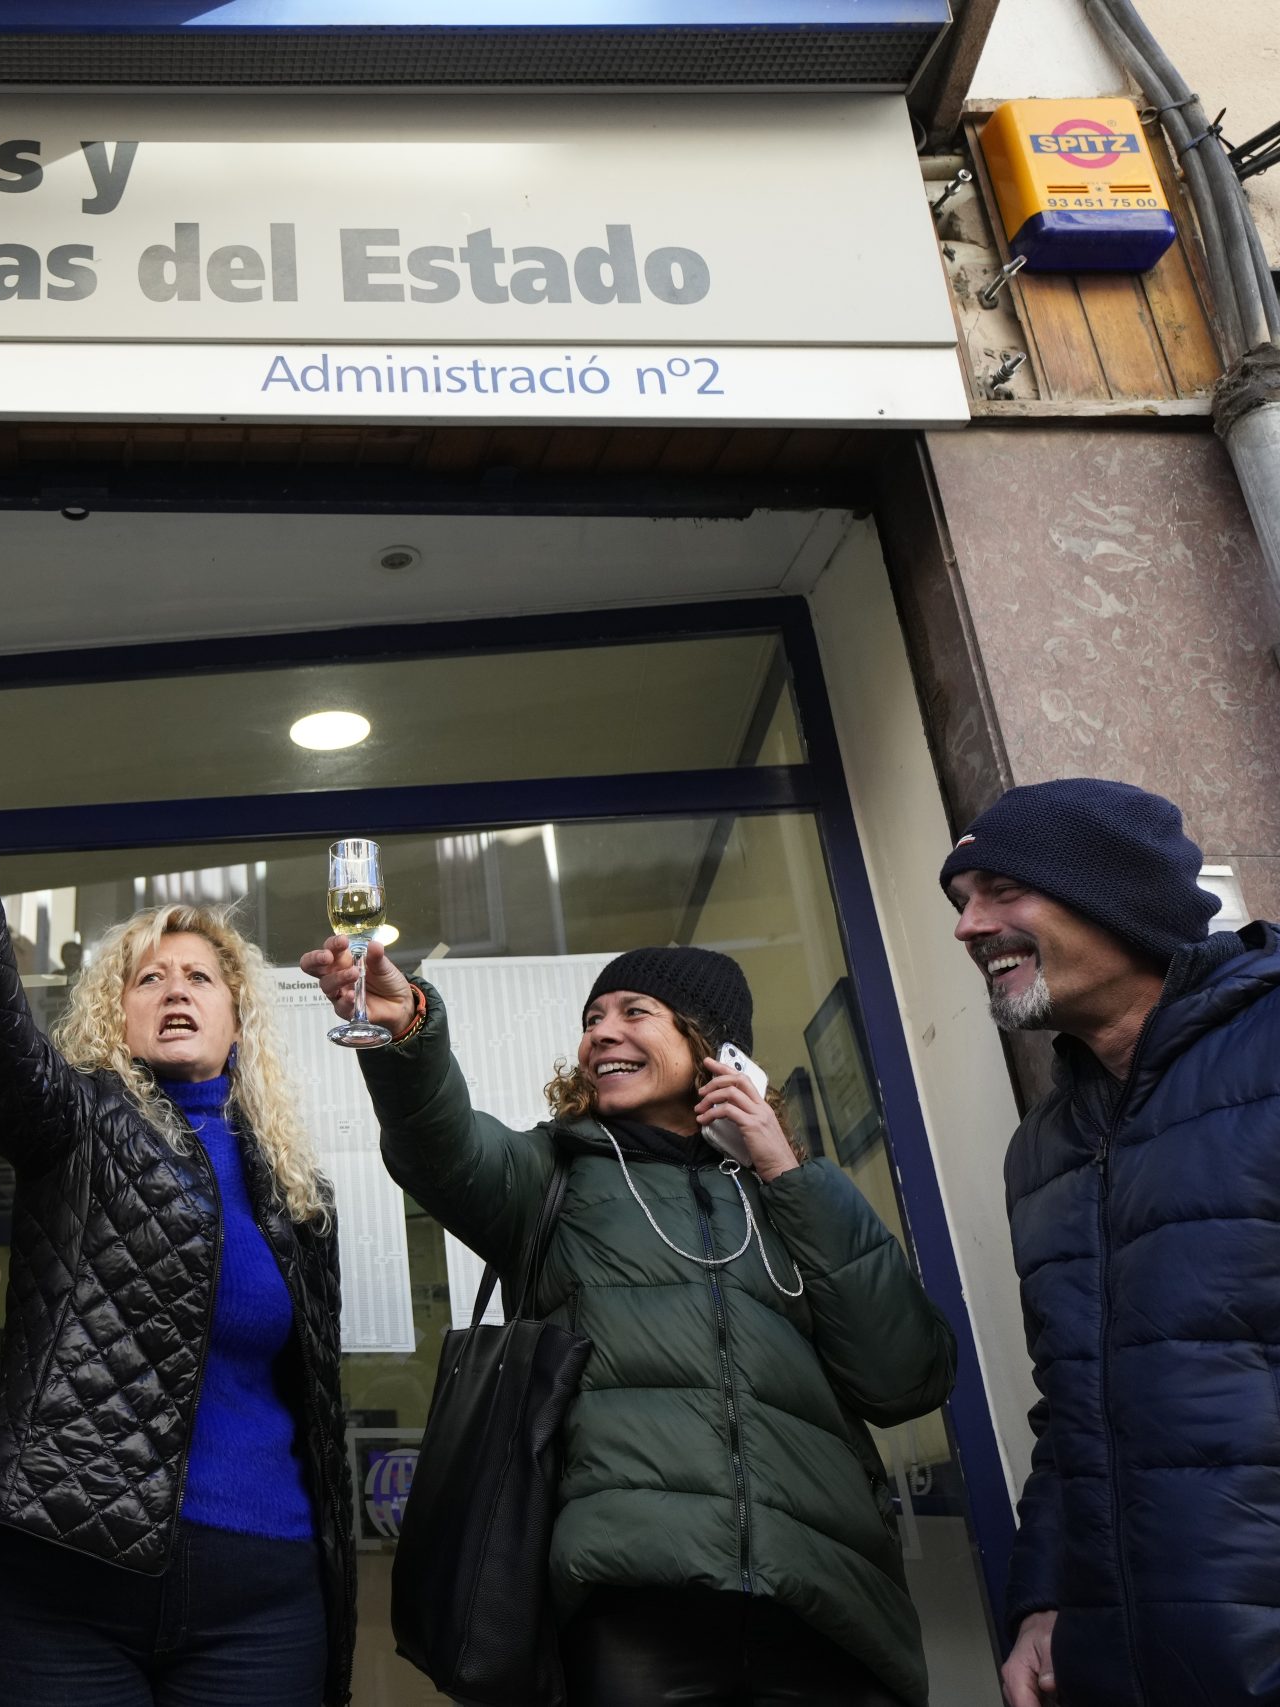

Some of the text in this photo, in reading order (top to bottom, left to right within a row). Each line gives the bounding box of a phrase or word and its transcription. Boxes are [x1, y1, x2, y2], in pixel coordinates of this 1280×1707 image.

[1037, 135, 1131, 153] SPITZ
[80, 140, 139, 215] y
[1048, 198, 1158, 208] 93 451 75 00
[137, 222, 299, 303] del
[339, 223, 711, 306] Estado
[261, 353, 611, 395] Administració
